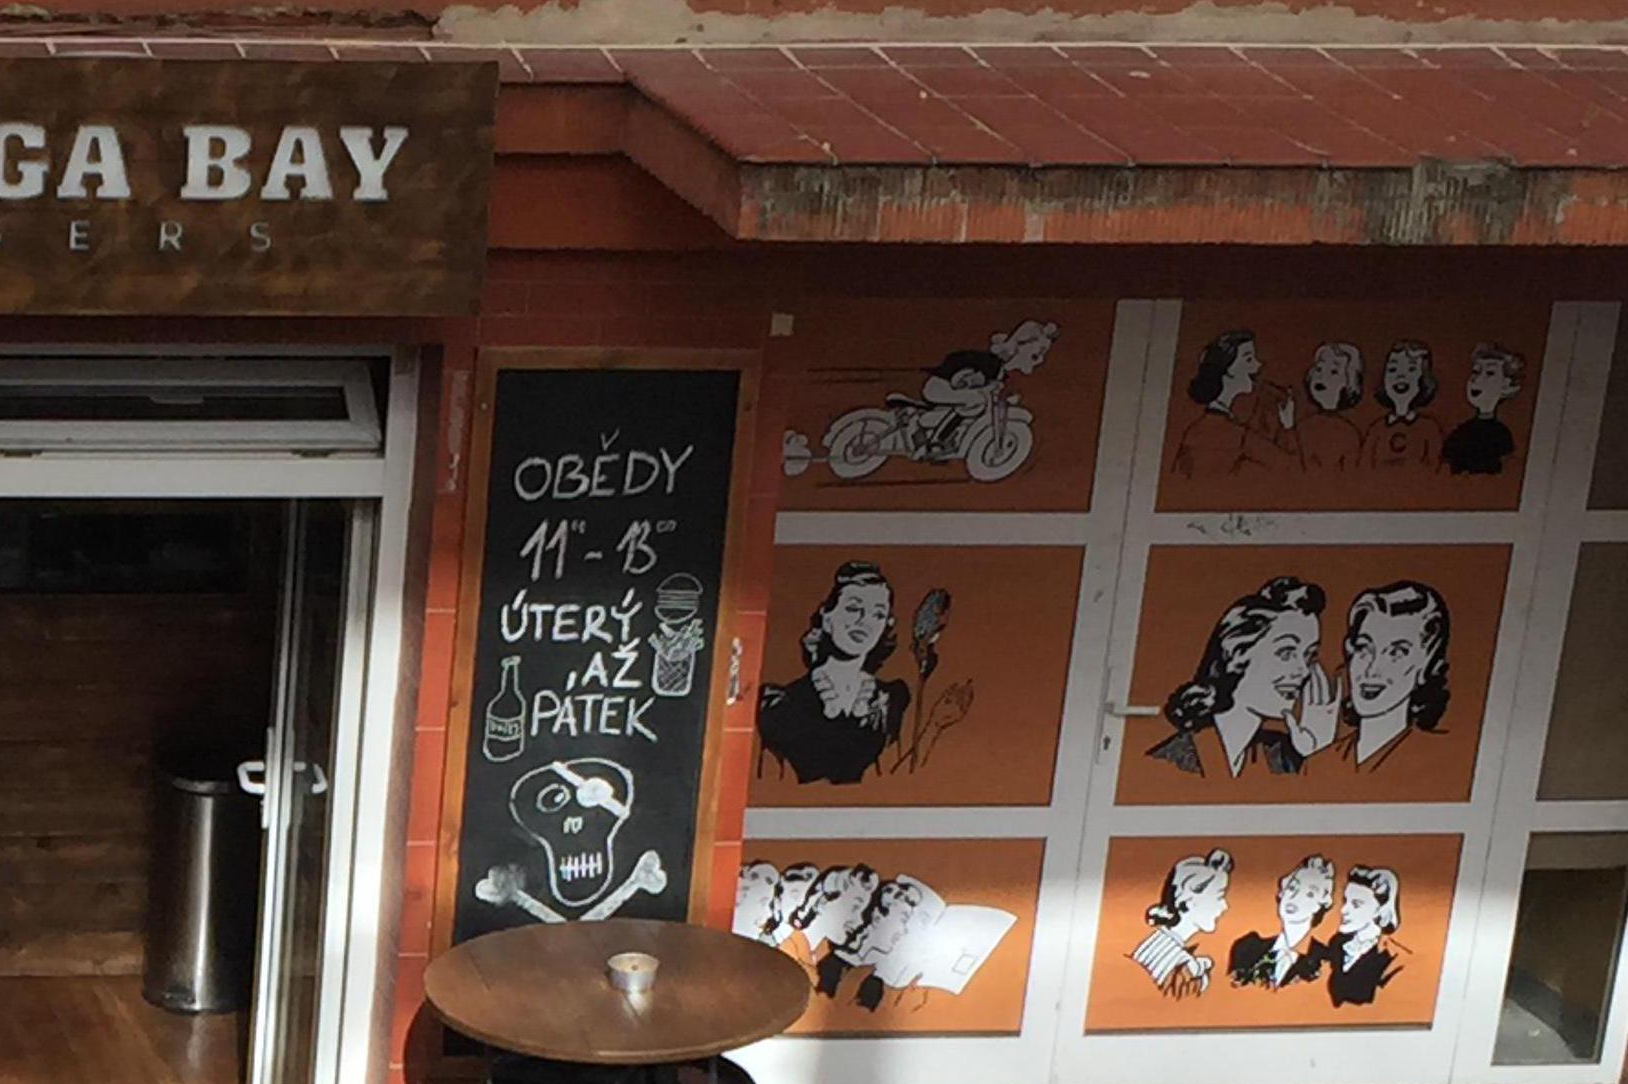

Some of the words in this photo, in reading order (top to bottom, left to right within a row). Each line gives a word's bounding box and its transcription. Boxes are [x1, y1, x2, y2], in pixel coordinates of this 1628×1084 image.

[179, 125, 411, 201] BAY
[514, 427, 694, 500] OBĚDY
[501, 588, 643, 643] ÚTERÝ
[581, 637, 643, 688] AŽ
[530, 671, 658, 743] PÁTEK
